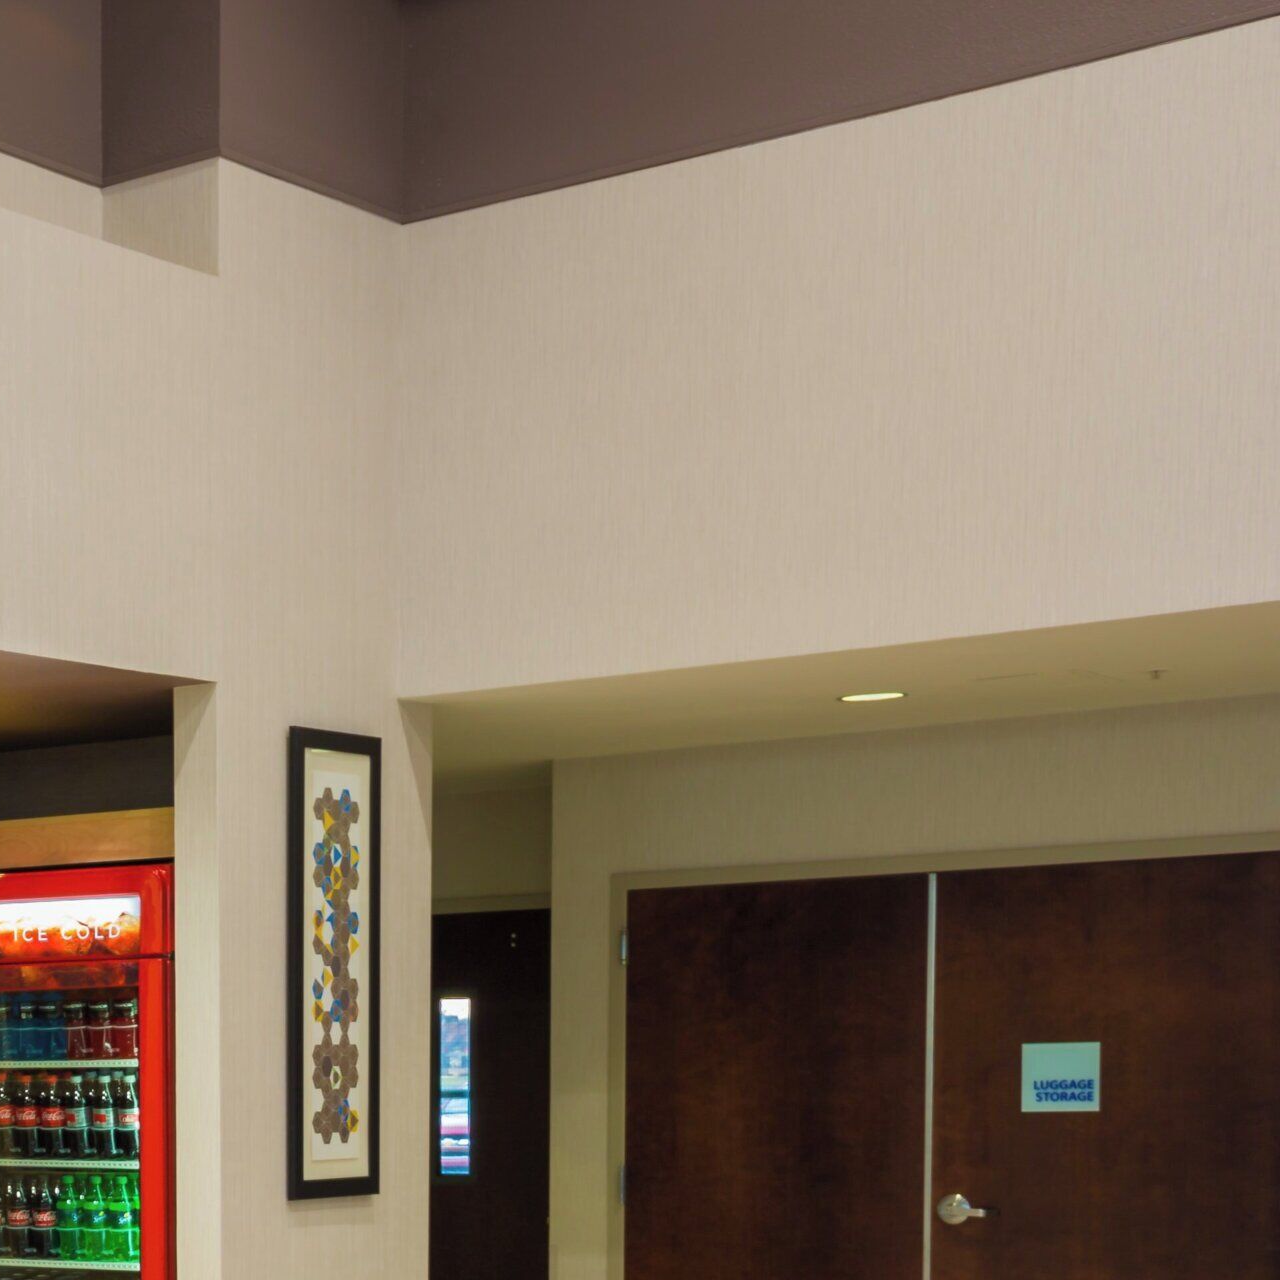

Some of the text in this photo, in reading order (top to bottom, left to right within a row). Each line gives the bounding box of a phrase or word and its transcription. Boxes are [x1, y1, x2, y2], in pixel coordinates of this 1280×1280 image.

[13, 925, 122, 943] ICE COLD
[1033, 1079, 1095, 1090] LUGGAGE
[1035, 1091, 1095, 1102] STORAGE
